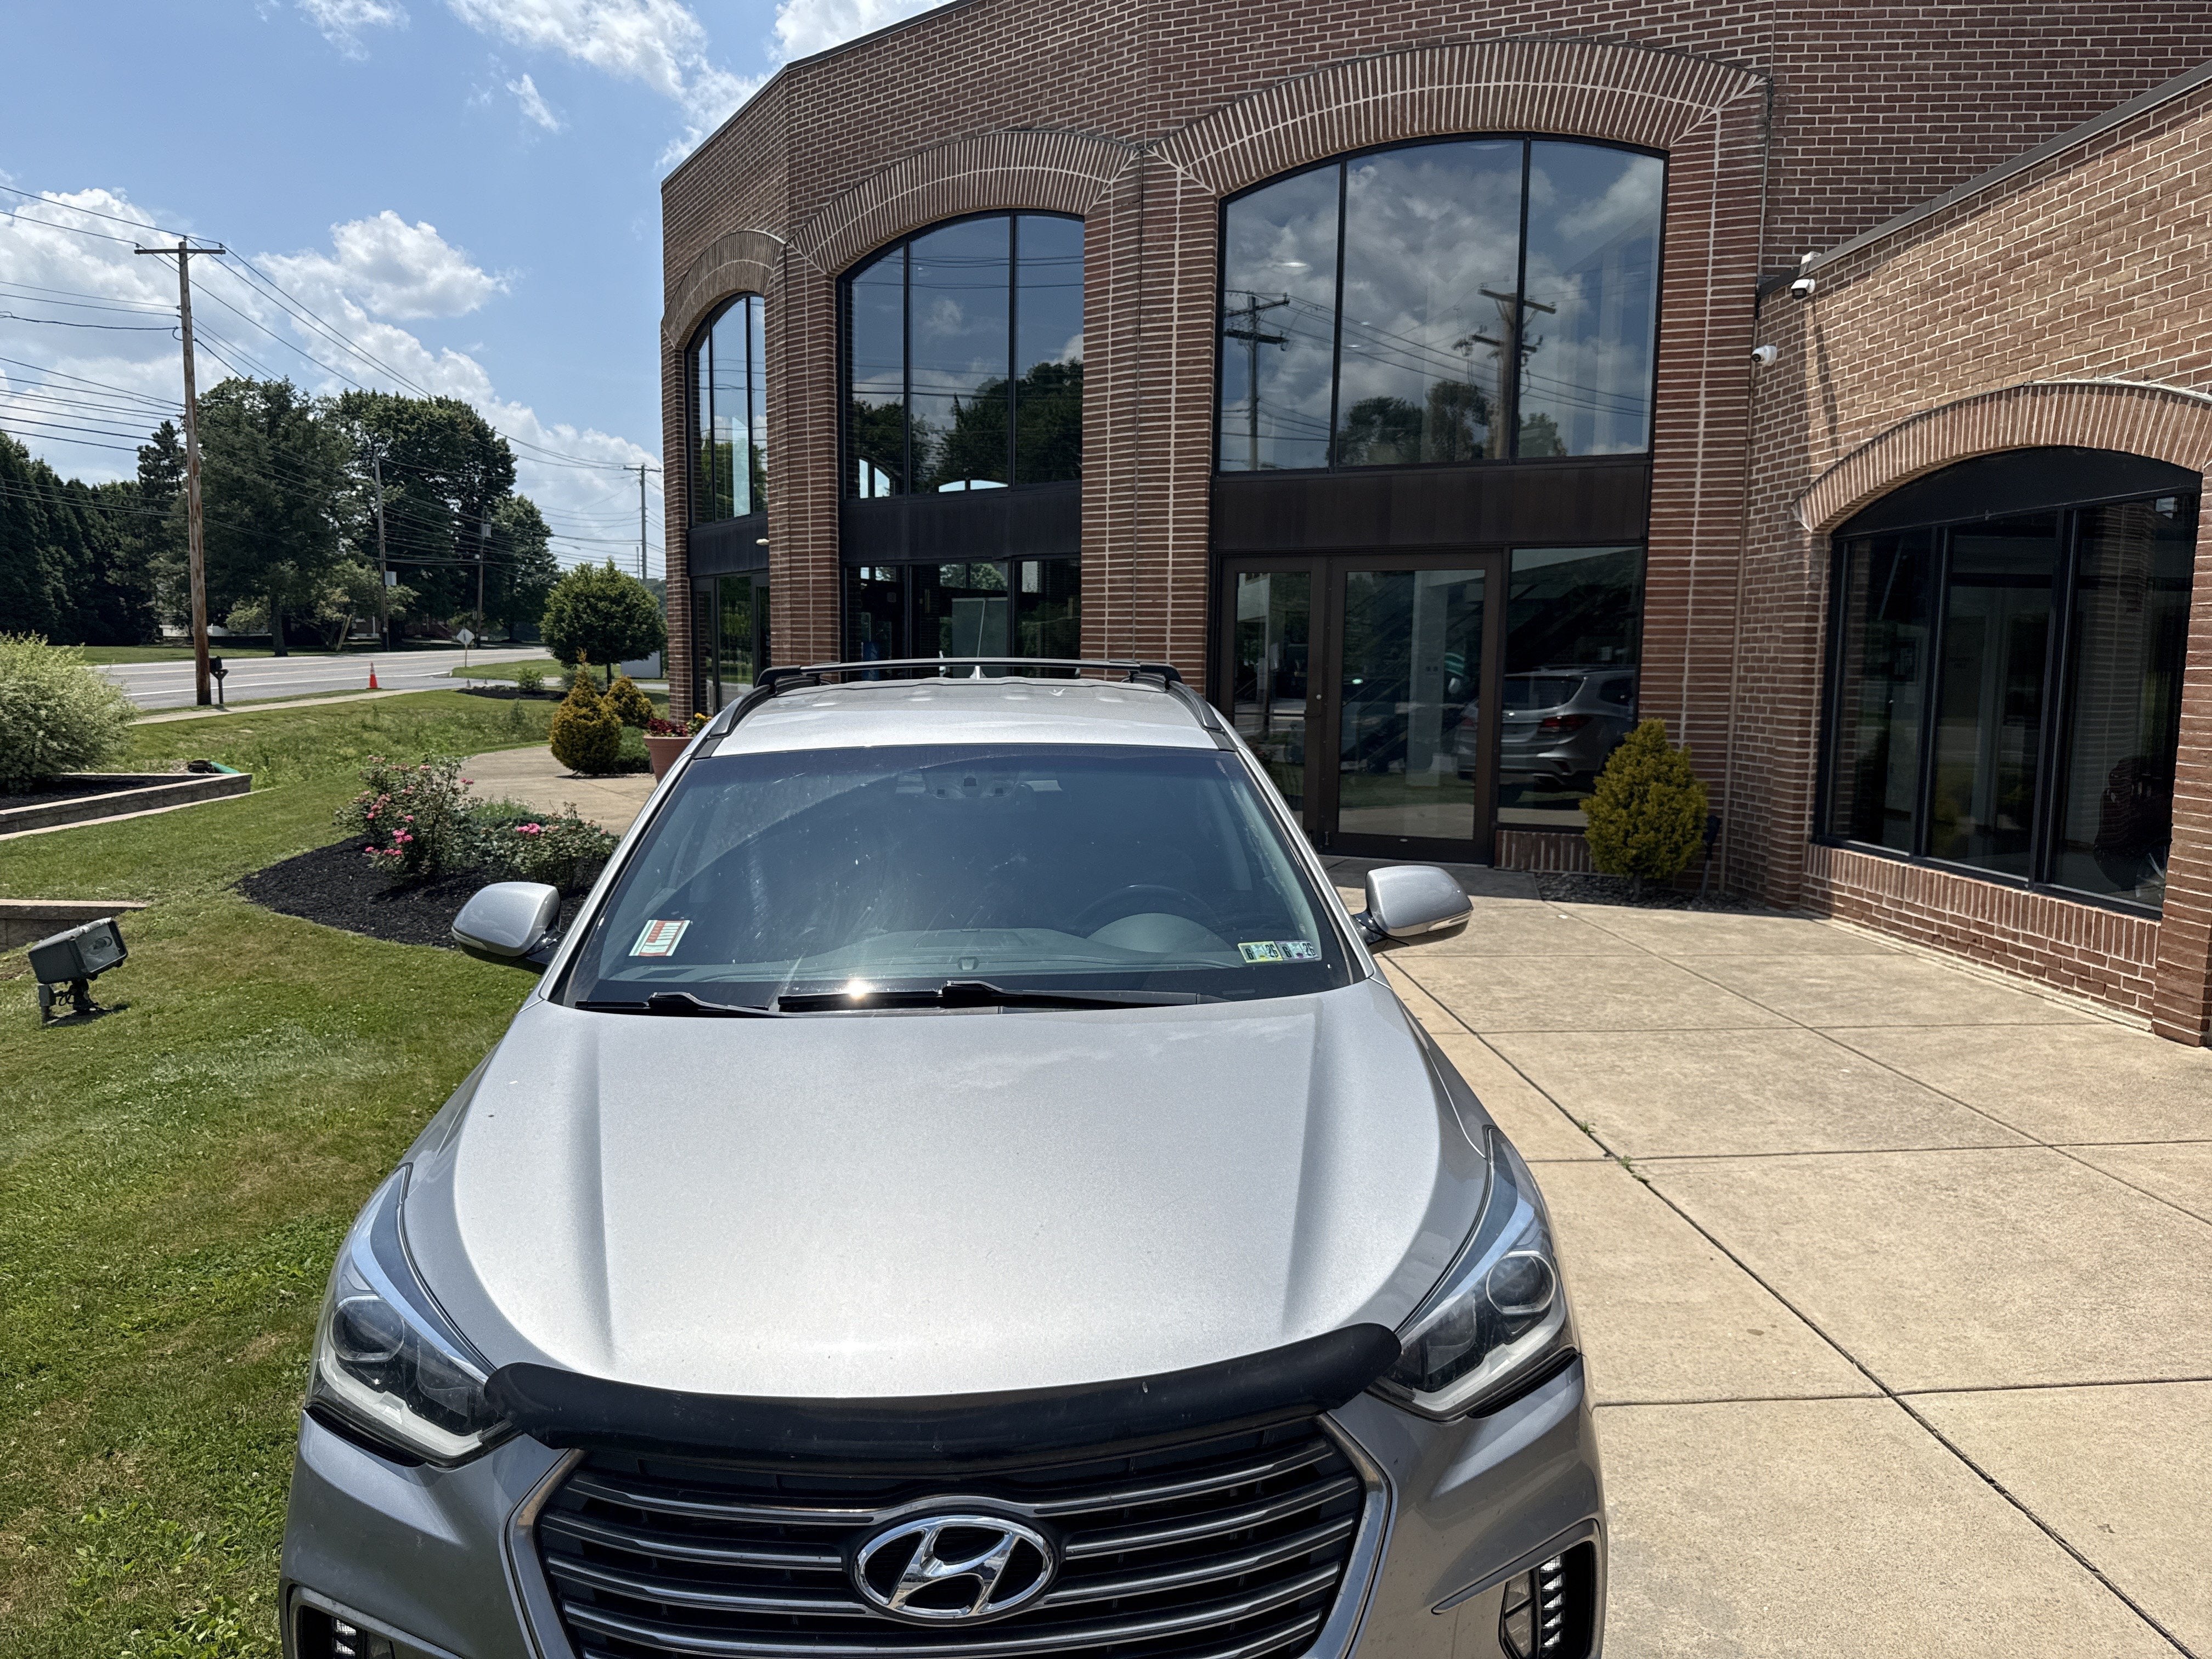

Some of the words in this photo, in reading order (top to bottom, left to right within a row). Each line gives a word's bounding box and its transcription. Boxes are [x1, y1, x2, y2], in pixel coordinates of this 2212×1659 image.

[1245, 948, 1255, 960] 6
[1282, 946, 1293, 958] 6
[1302, 943, 1316, 956] 26
